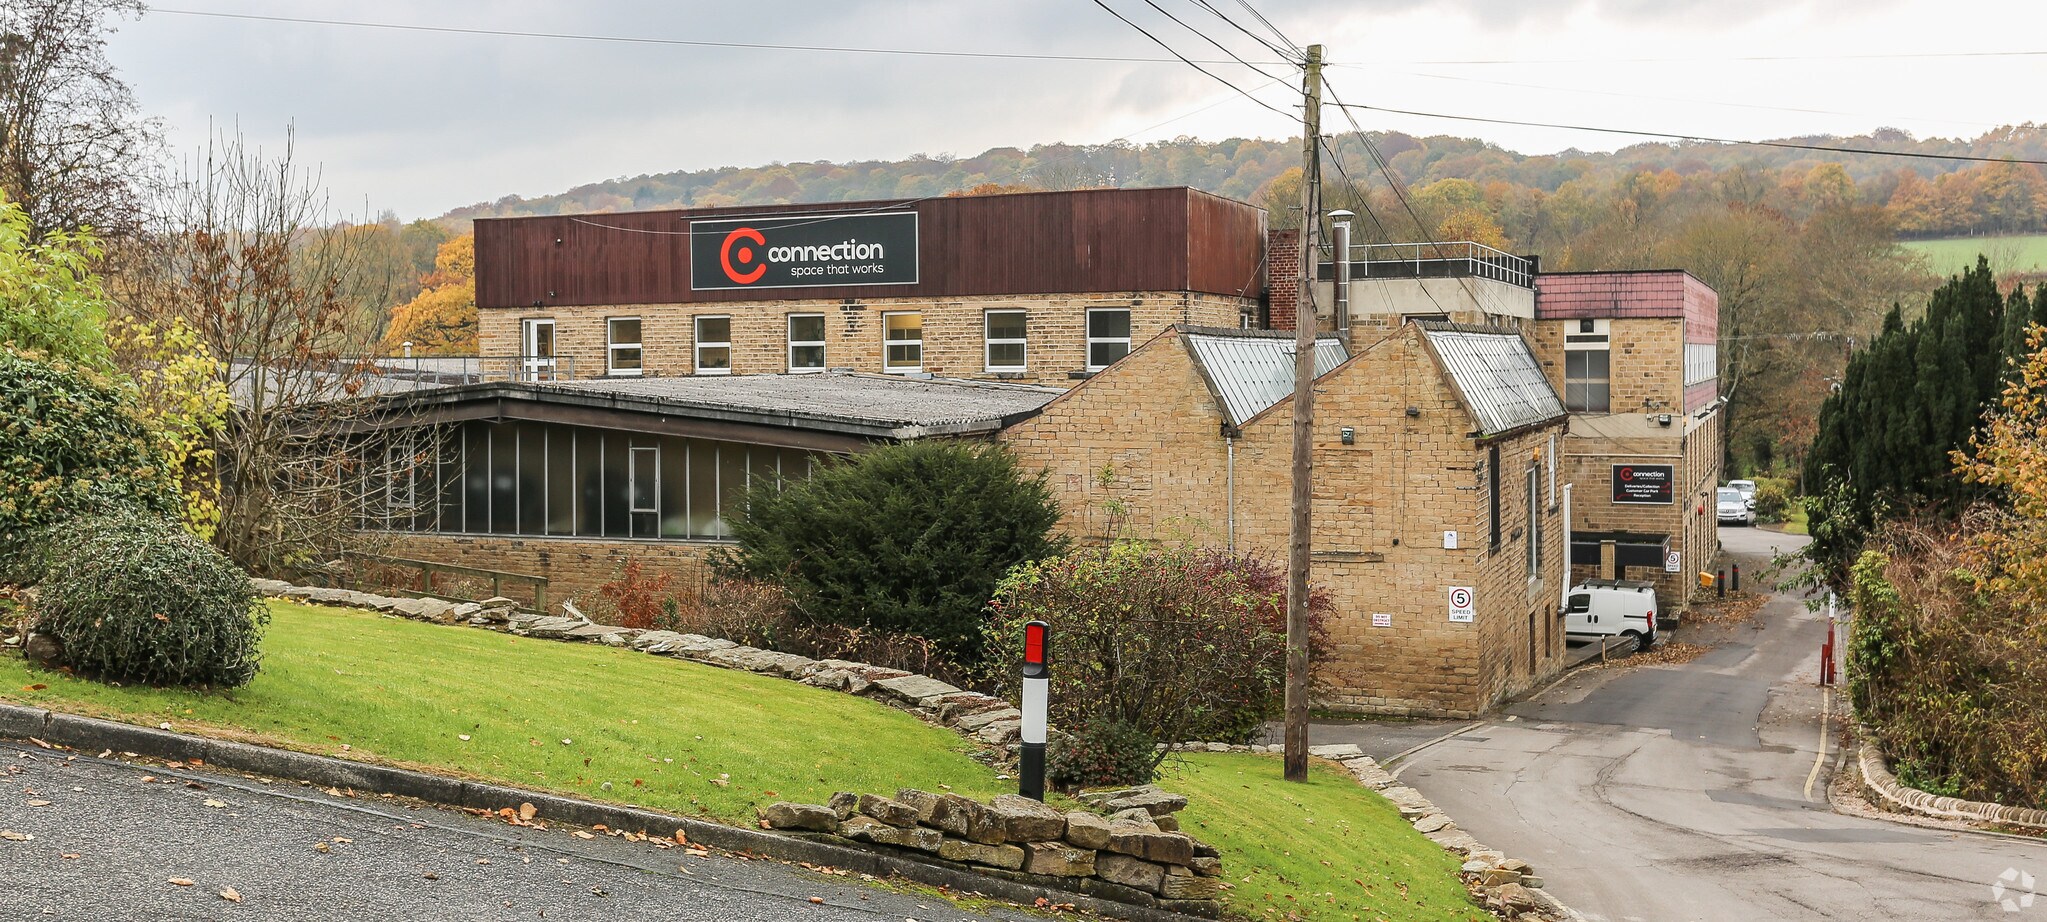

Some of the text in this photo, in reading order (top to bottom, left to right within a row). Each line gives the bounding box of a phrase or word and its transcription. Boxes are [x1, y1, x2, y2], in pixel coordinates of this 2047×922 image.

[768, 238, 884, 263] connection
[791, 263, 884, 278] space that works
[1456, 593, 1465, 604] 5
